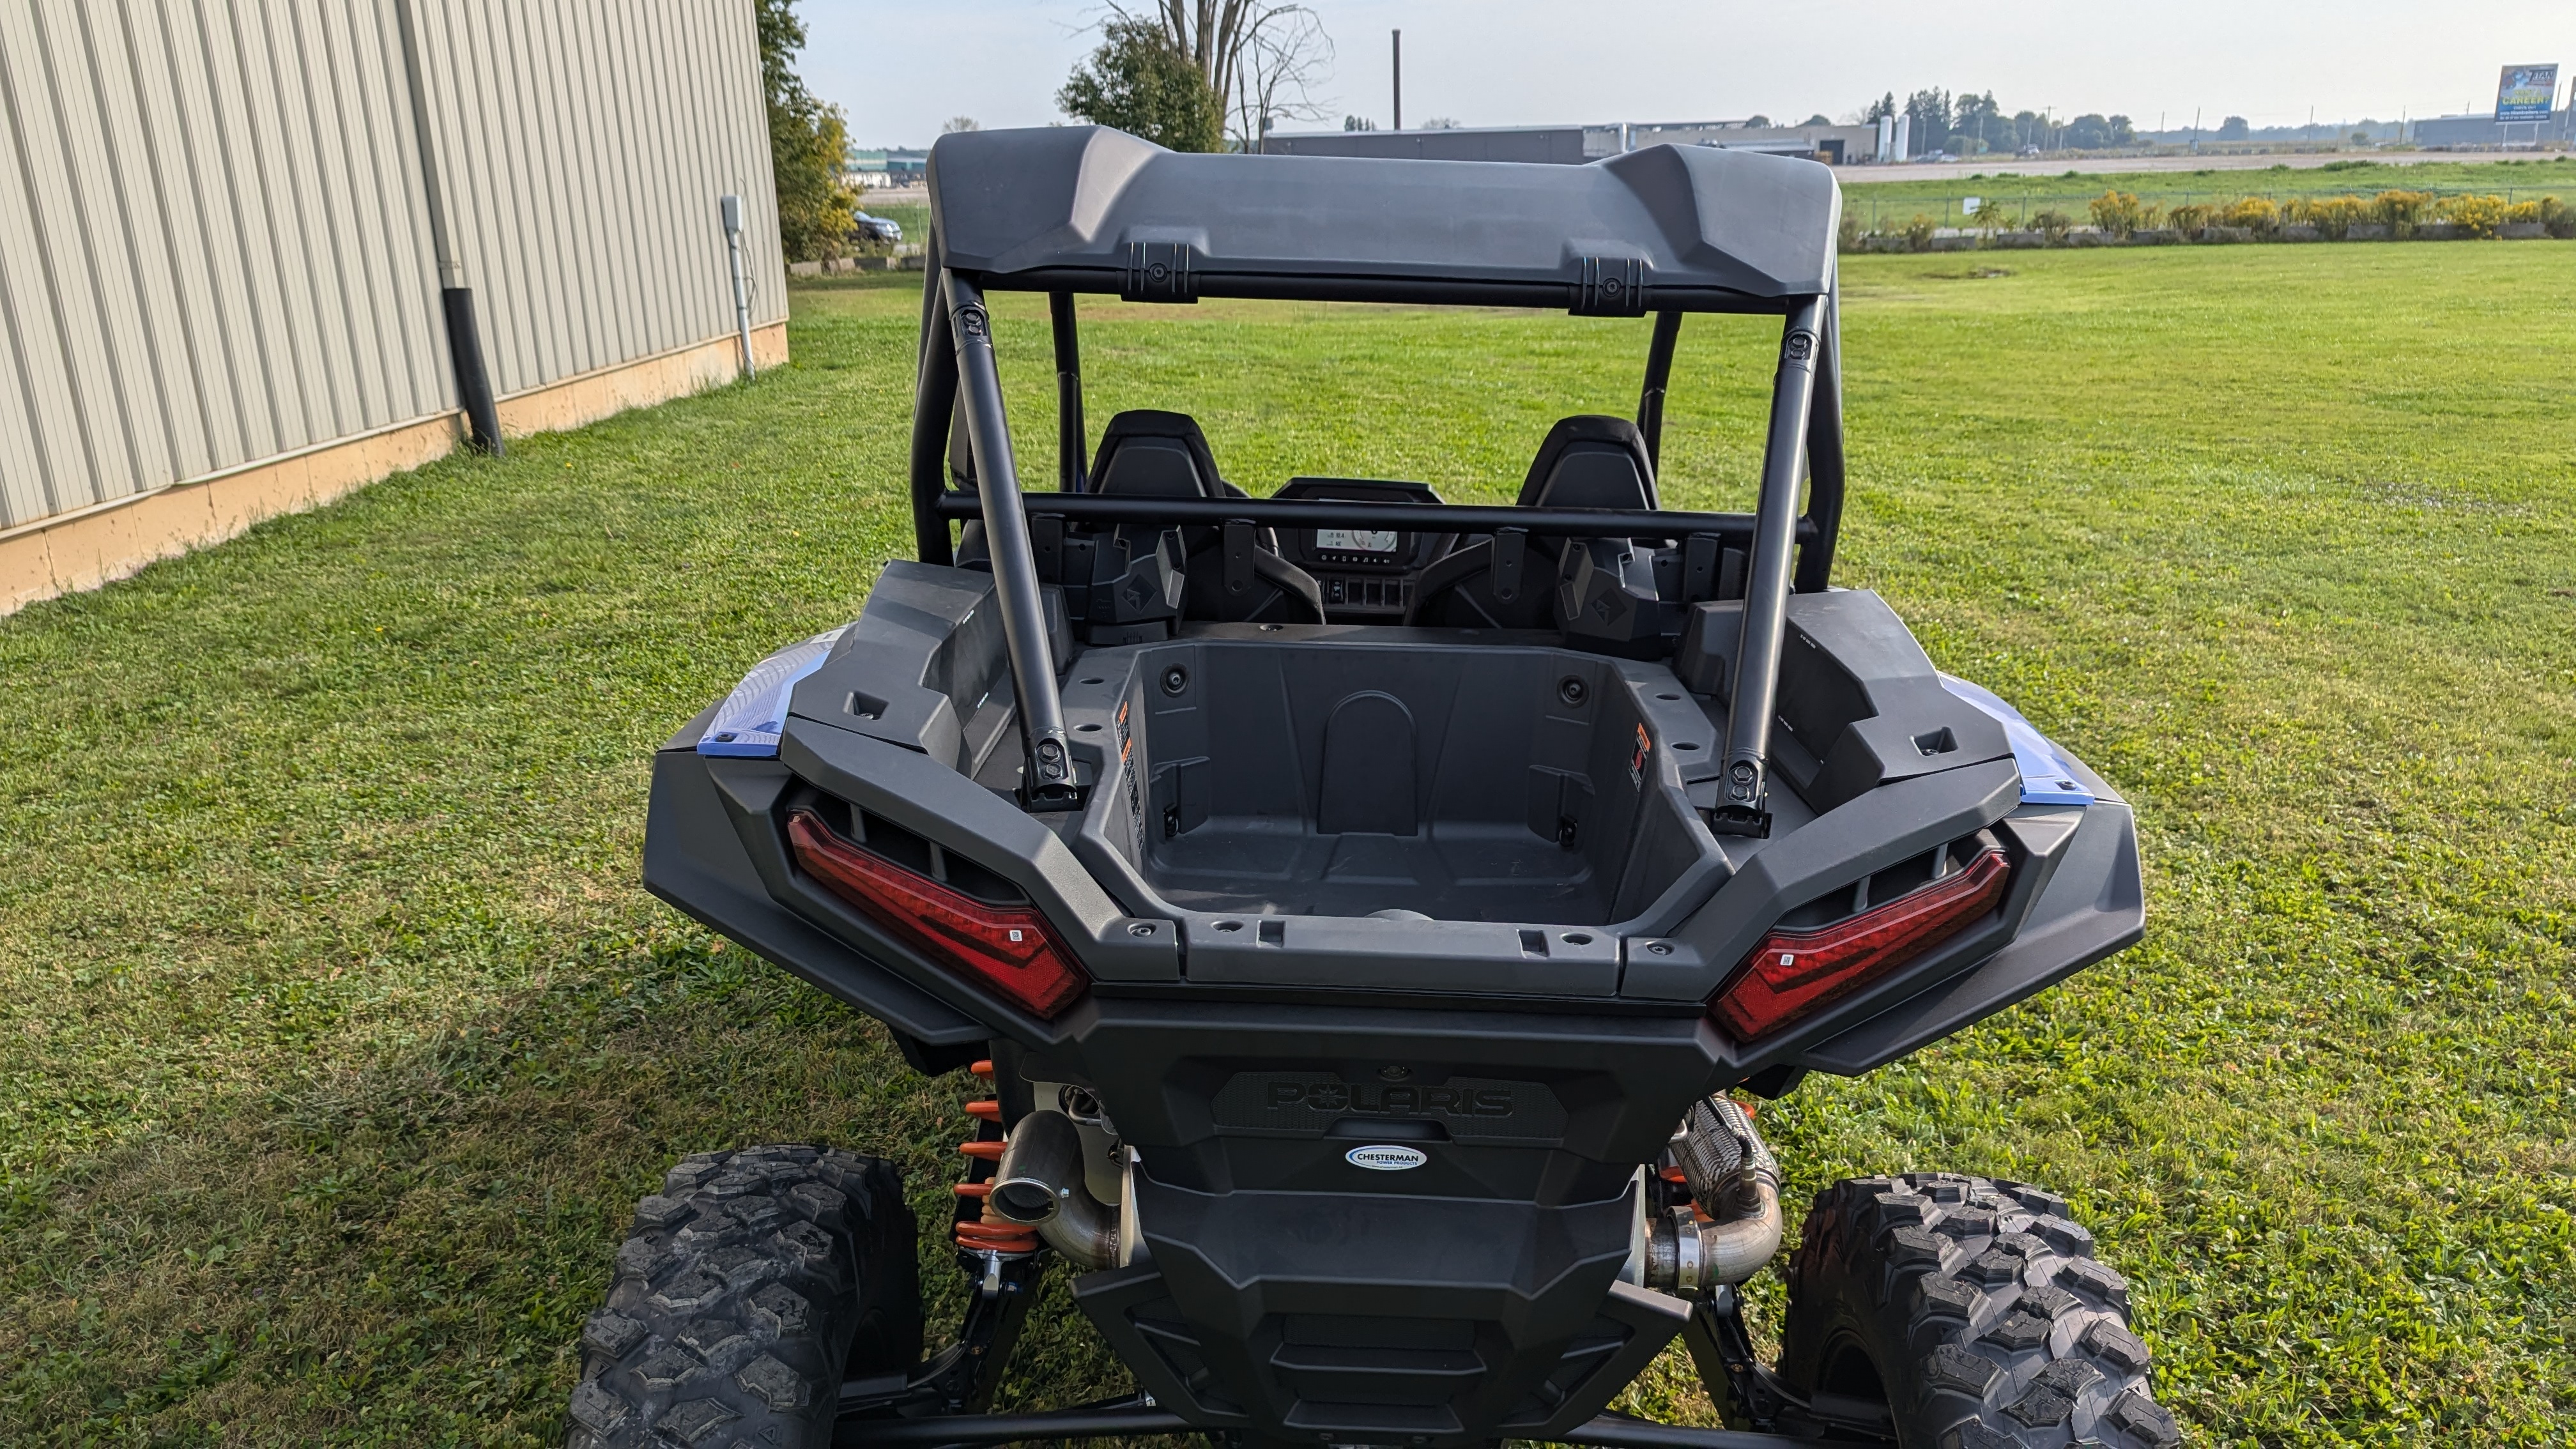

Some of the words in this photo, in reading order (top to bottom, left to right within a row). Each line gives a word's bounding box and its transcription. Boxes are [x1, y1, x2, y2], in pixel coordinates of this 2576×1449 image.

[2529, 69, 2554, 81] TITAN
[2502, 96, 2550, 105] CAREER?
[1267, 1082, 1513, 1117] POLARIS
